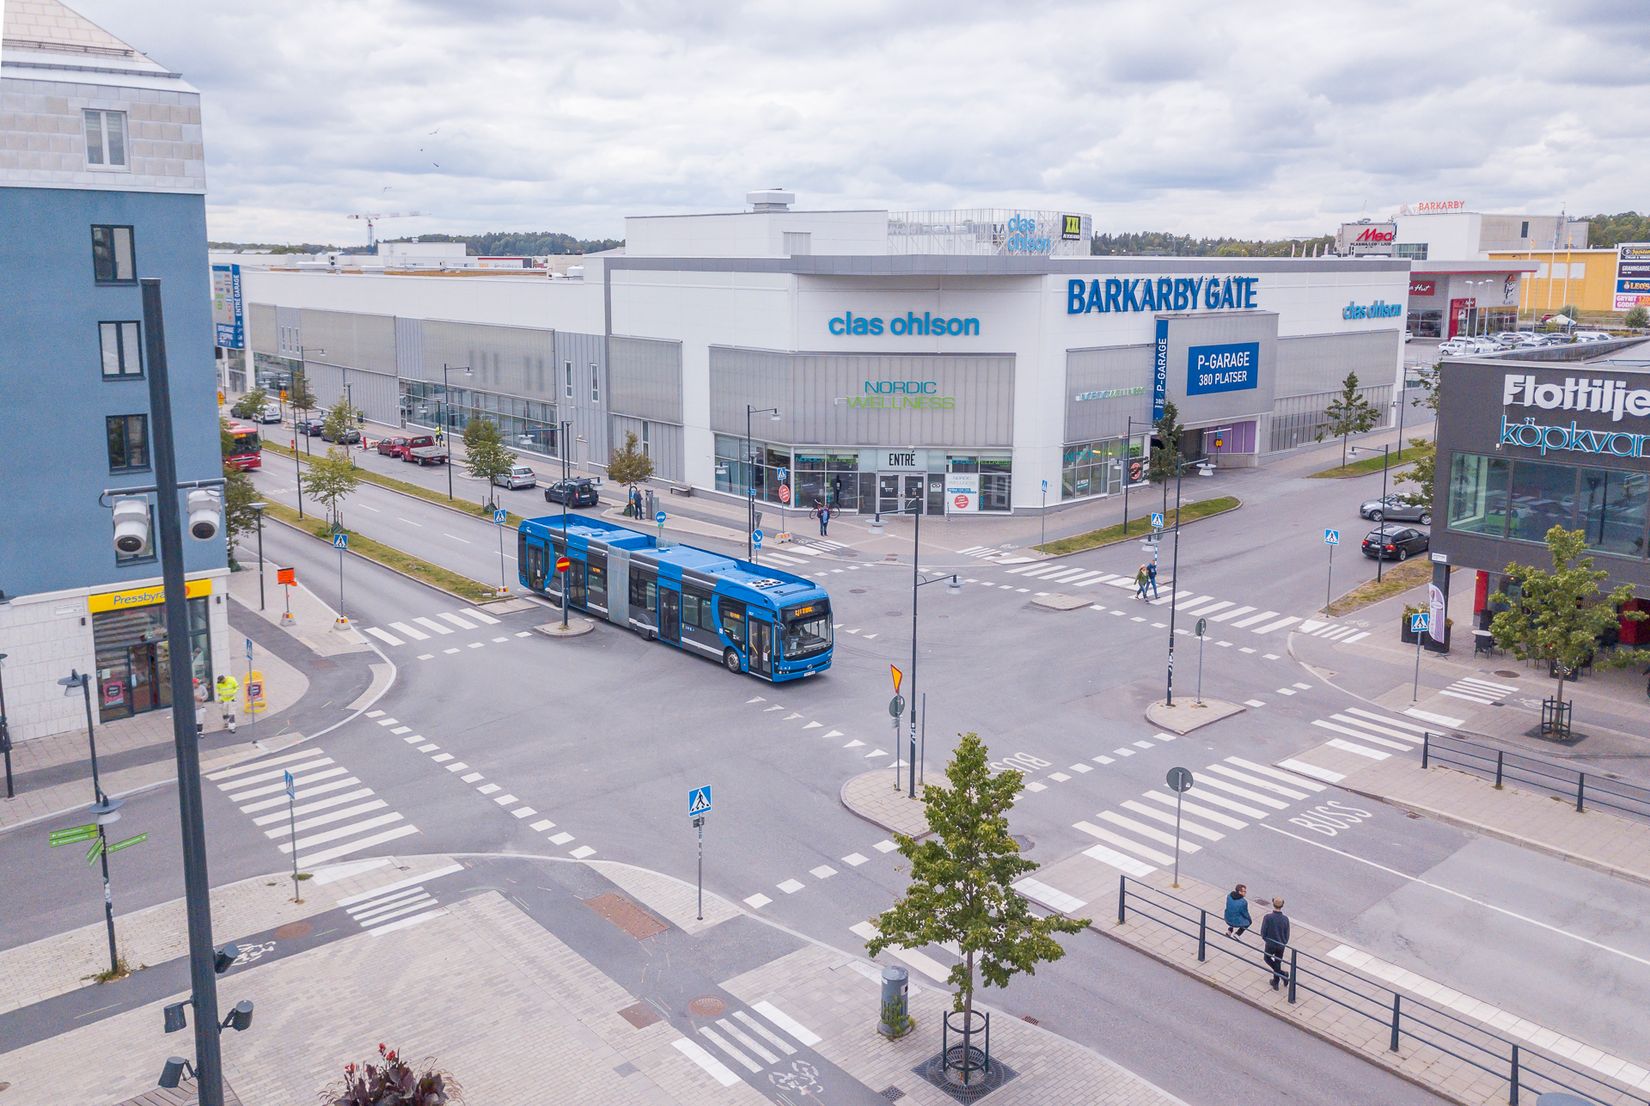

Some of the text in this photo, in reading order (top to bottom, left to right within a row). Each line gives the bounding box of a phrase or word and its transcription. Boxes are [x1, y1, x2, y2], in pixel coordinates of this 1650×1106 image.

[1418, 201, 1465, 212] BARKARBY
[1008, 213, 1036, 232] clas
[1065, 216, 1080, 233] XXL
[1068, 277, 1259, 314] BARKARBY GATE
[1342, 300, 1402, 319] clas ohlson
[828, 311, 980, 336] clas ohlson
[1156, 338, 1167, 392] P-GARAGE
[1197, 351, 1250, 370] P-GARAGE
[864, 380, 937, 394] NORDIC
[1198, 370, 1248, 387] 380 PLATSER
[847, 396, 956, 409] WELLNESS
[1503, 374, 1650, 421] Flottilje
[888, 450, 916, 467] ENTRÉ
[1287, 800, 1373, 837] BUSS
